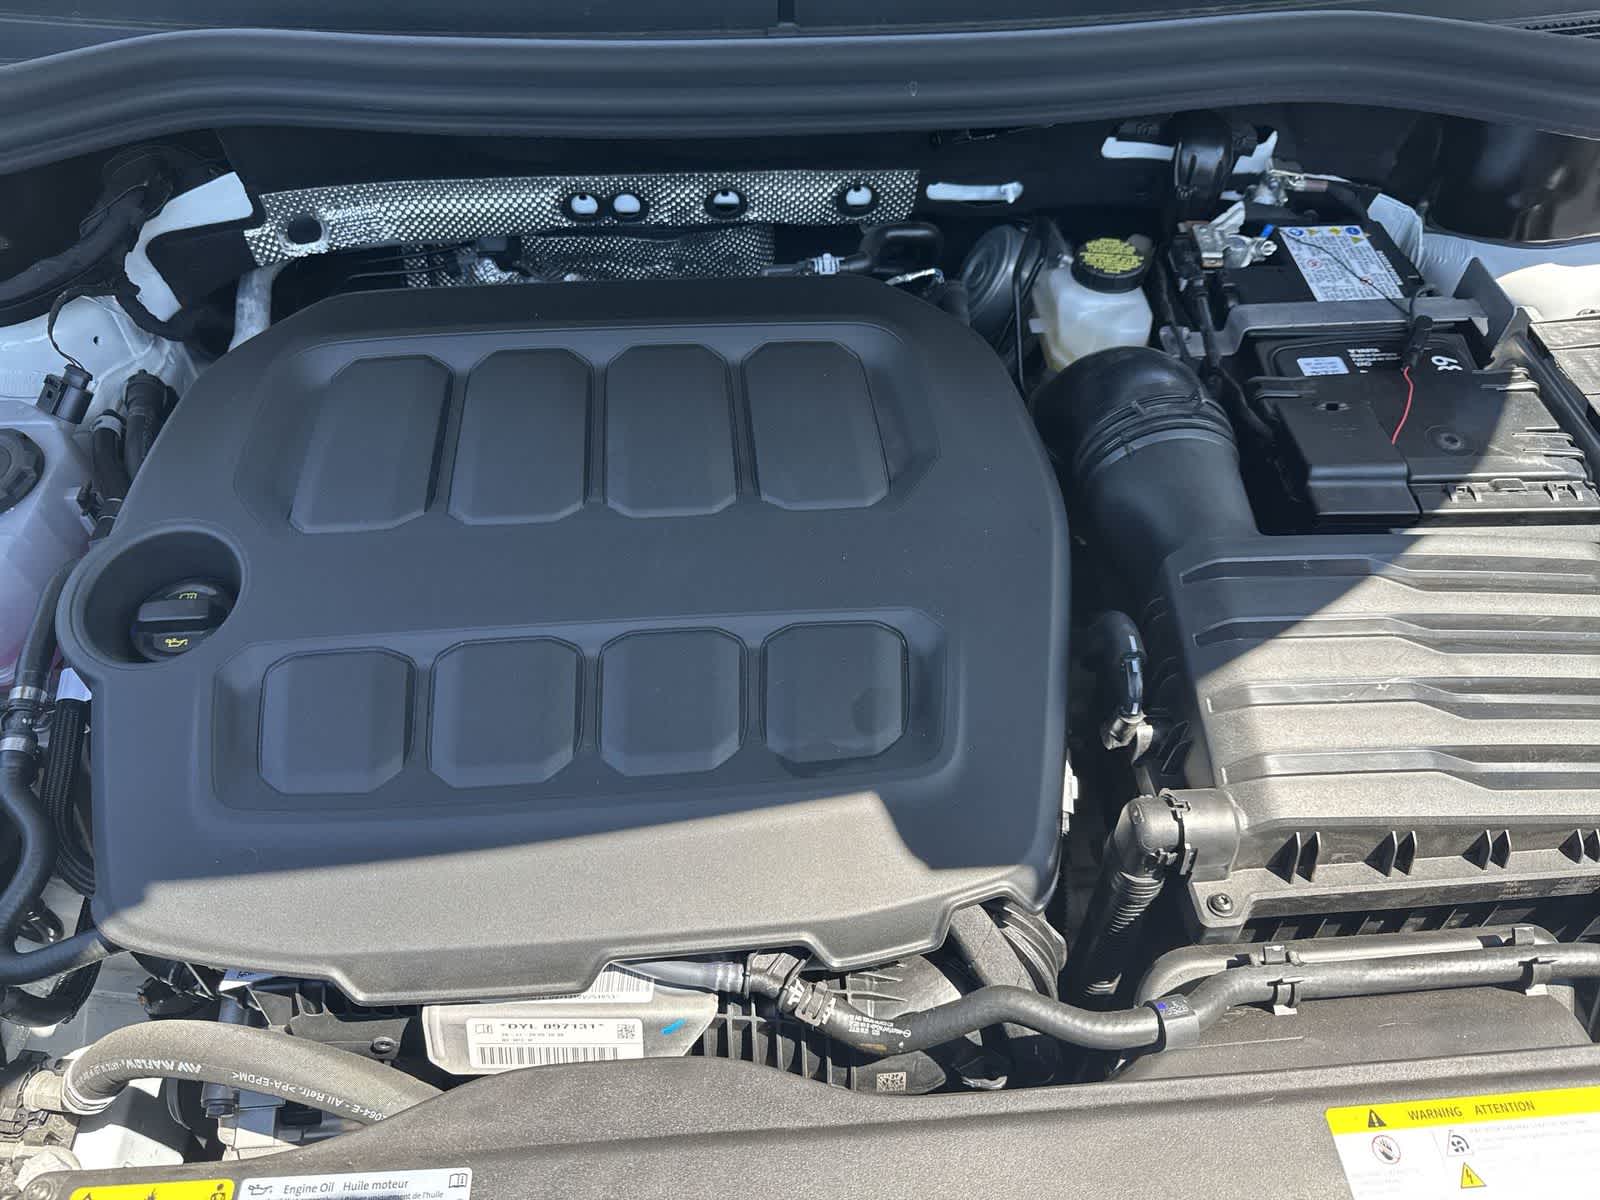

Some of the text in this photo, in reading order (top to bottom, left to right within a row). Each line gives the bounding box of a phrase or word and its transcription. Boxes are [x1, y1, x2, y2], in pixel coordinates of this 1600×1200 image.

[299, 1086, 326, 1101] Refr.
[328, 1096, 344, 1107] All
[1407, 1100, 1536, 1121] WARNING ATTENTION
[283, 1180, 409, 1196] Engine Oil Huile moteur
